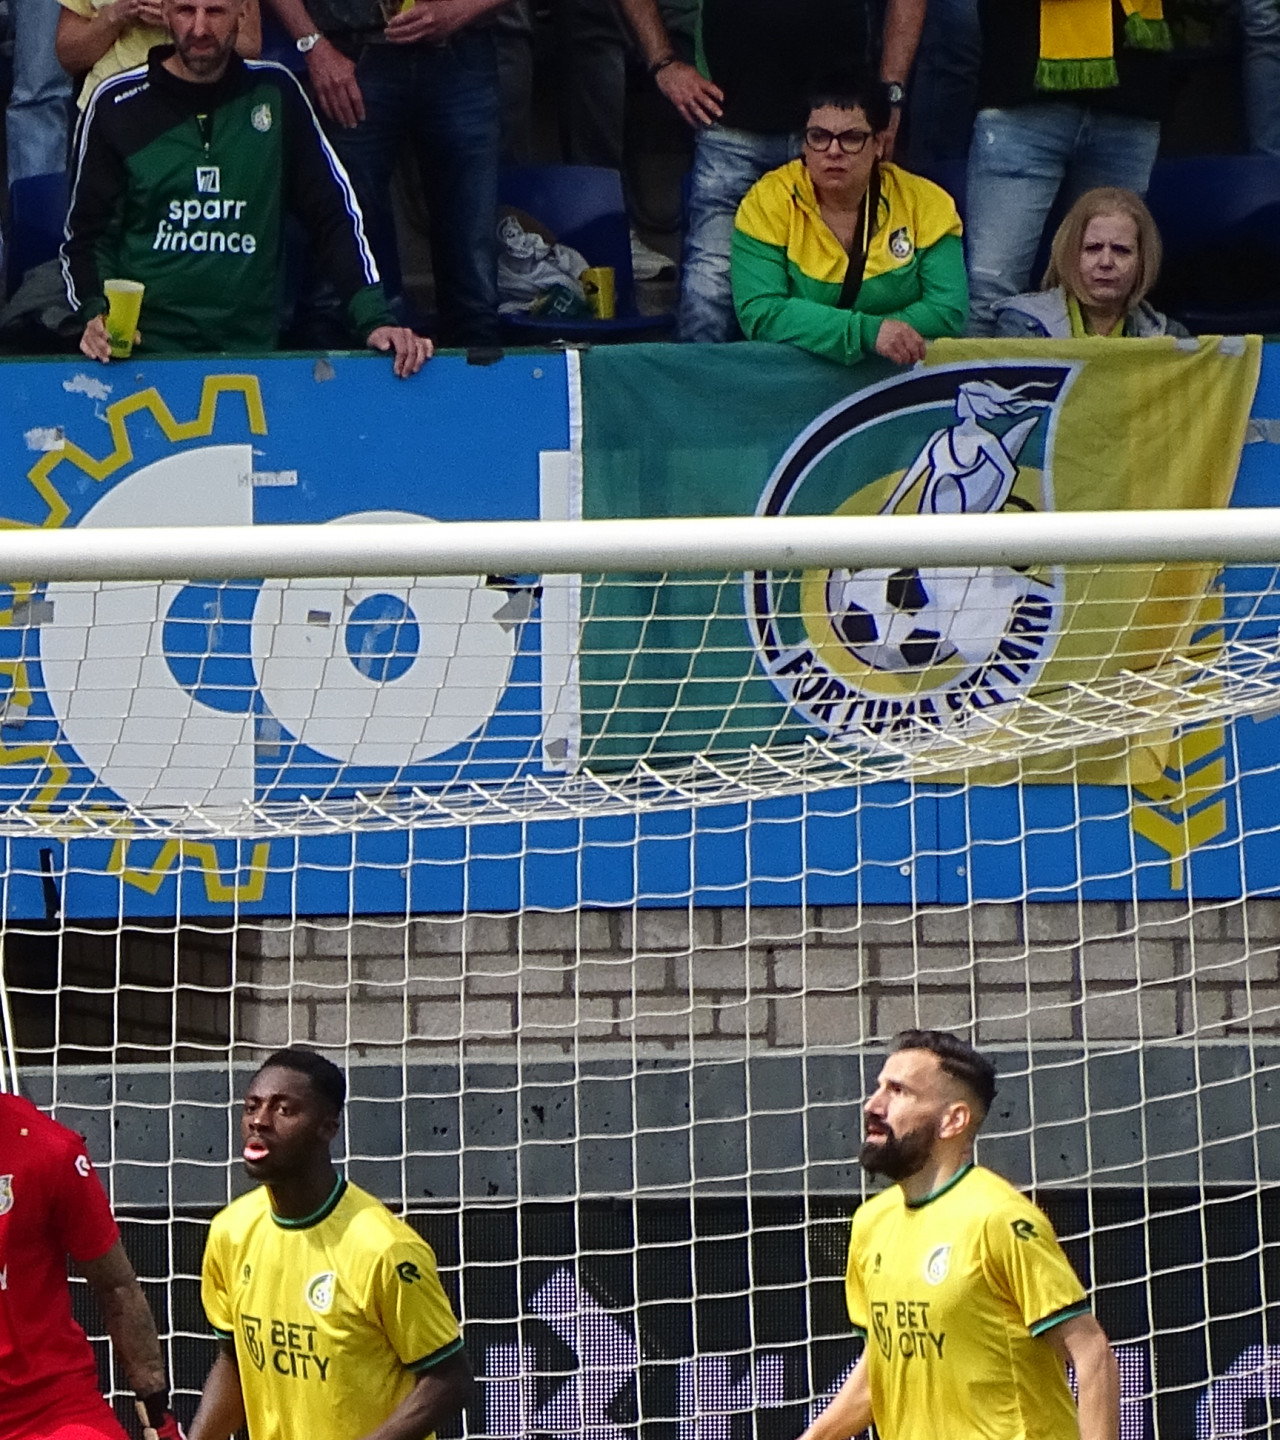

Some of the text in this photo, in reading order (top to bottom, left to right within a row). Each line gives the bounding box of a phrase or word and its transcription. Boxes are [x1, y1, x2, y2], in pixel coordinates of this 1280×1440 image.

[168, 198, 247, 228] sparr
[152, 220, 257, 254] finance
[775, 593, 1053, 736] FORTUNA SITTARD
[895, 1300, 930, 1330] BET
[270, 1319, 318, 1352] BET
[898, 1330, 947, 1360] CITY
[272, 1349, 330, 1382] CITY
